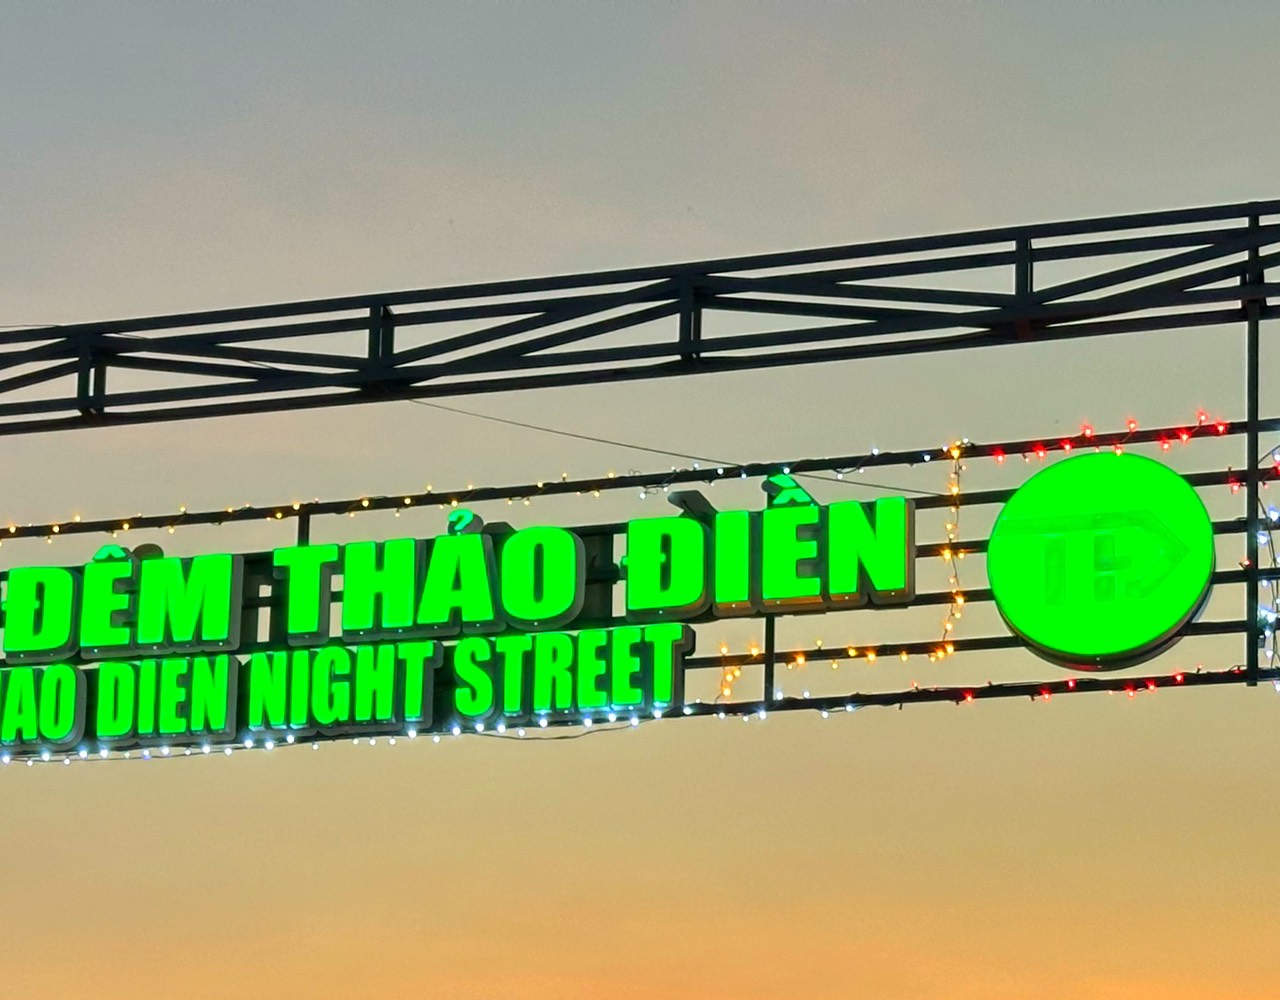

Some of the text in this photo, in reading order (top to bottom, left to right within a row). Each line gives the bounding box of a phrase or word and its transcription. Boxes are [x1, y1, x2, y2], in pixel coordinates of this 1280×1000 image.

[1, 544, 233, 651] ĐÊM
[272, 508, 577, 633] THẢO
[618, 474, 907, 610] ĐIỀN
[96, 654, 230, 738] DIEN
[249, 641, 435, 728] NIGHT
[454, 623, 683, 717] STREET
